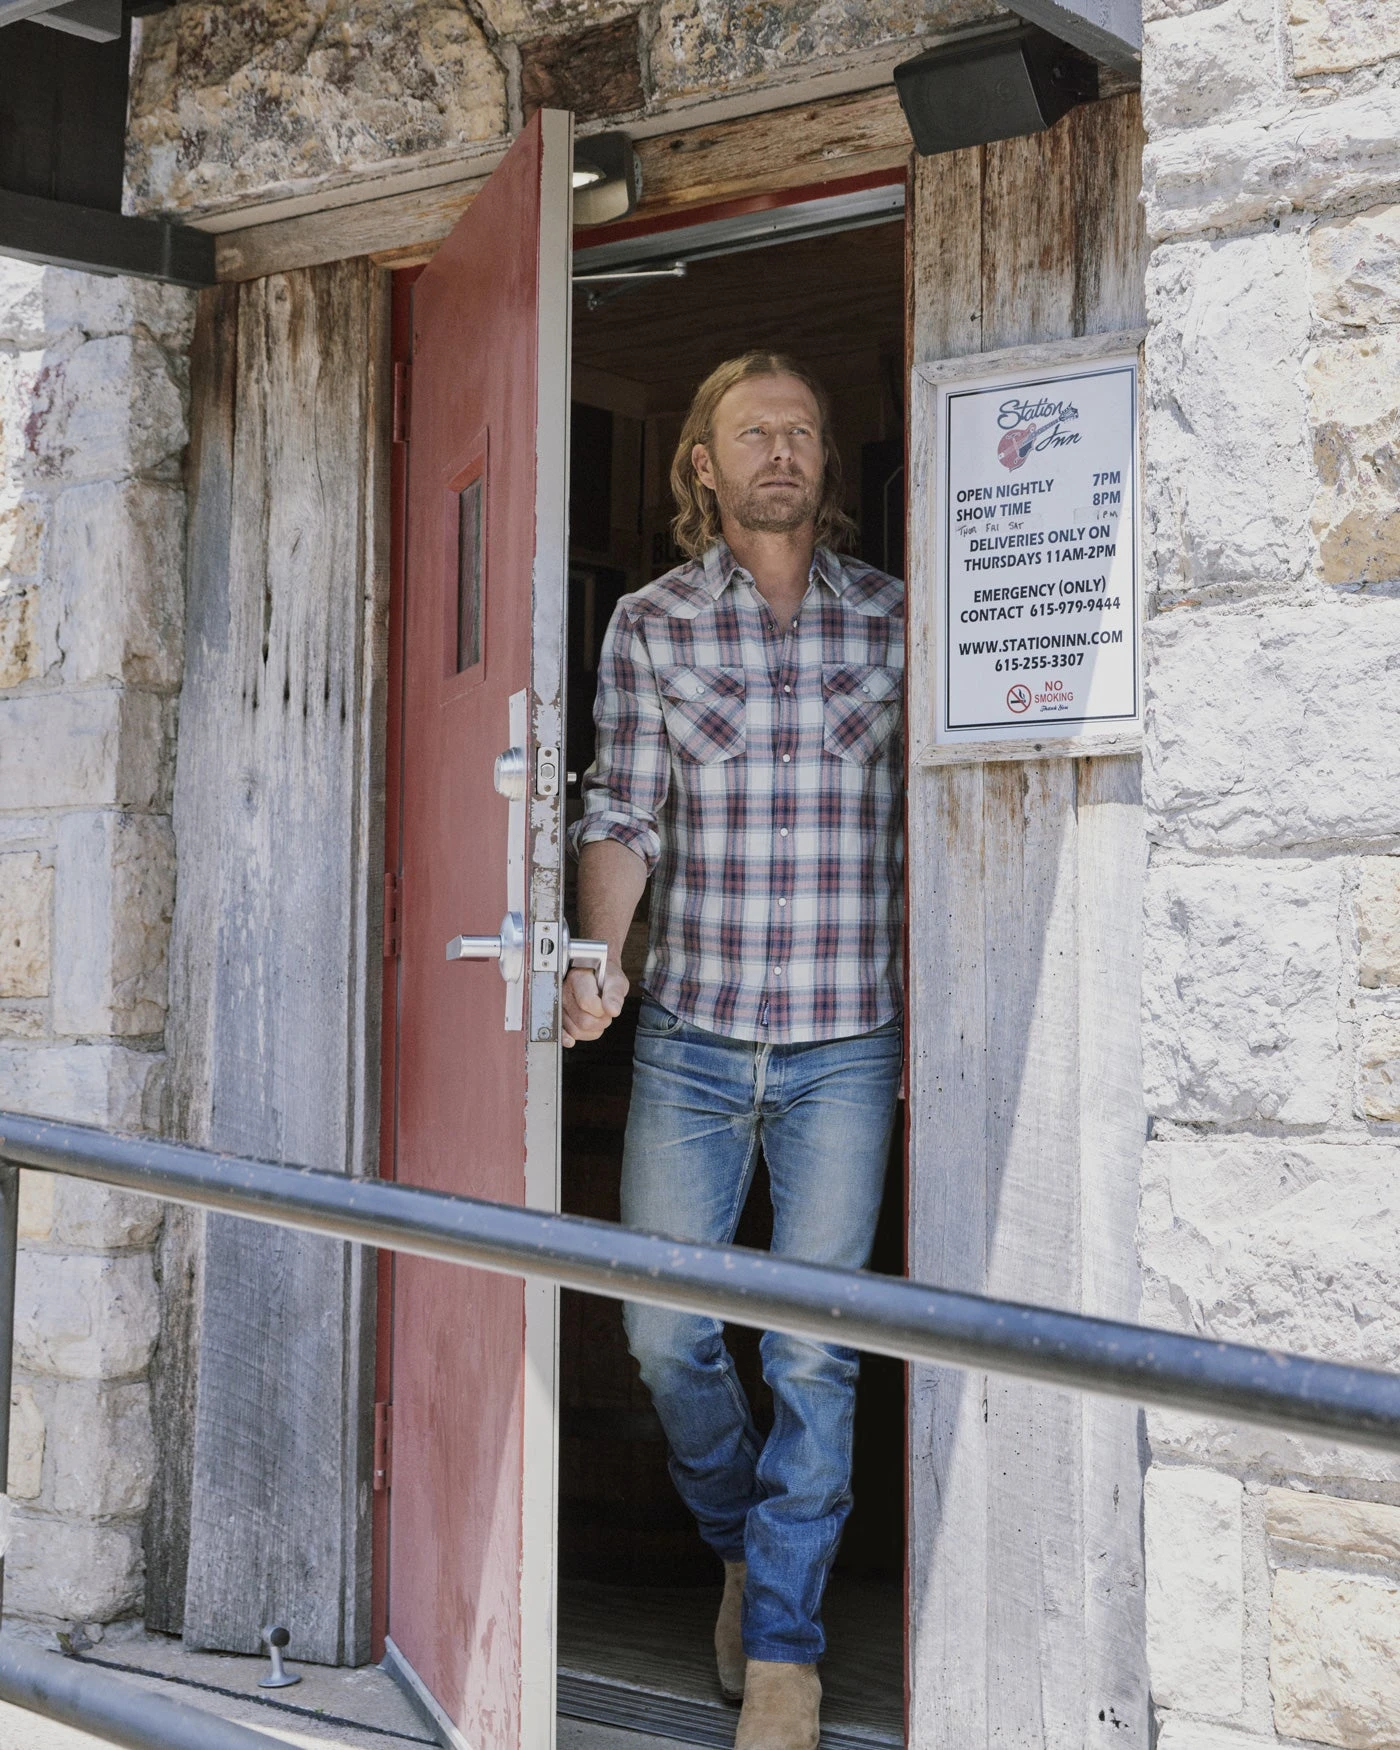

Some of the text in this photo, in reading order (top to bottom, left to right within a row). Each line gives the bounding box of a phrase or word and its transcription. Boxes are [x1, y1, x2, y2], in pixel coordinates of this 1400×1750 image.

[997, 397, 1064, 430] Station
[1035, 423, 1082, 452] Inn
[956, 471, 1121, 503] OPEN NIGHTLY 7PM
[956, 491, 1121, 522] SHOW TIME 8PM
[970, 525, 1110, 552] DELIVERIES ONLY ON
[1008, 521, 1024, 530] SAT
[964, 544, 1116, 571] THURSDAYS 11AM-2PM
[973, 576, 1106, 603] EMERGENCY (ONLY)
[960, 597, 1120, 623] CONTACT 615-979-9444
[959, 630, 1123, 655] WWW.STATIONINN.COM
[995, 653, 1084, 672] 615-255-3307
[1034, 692, 1074, 703] SMOKING
[1045, 680, 1063, 691] NO
